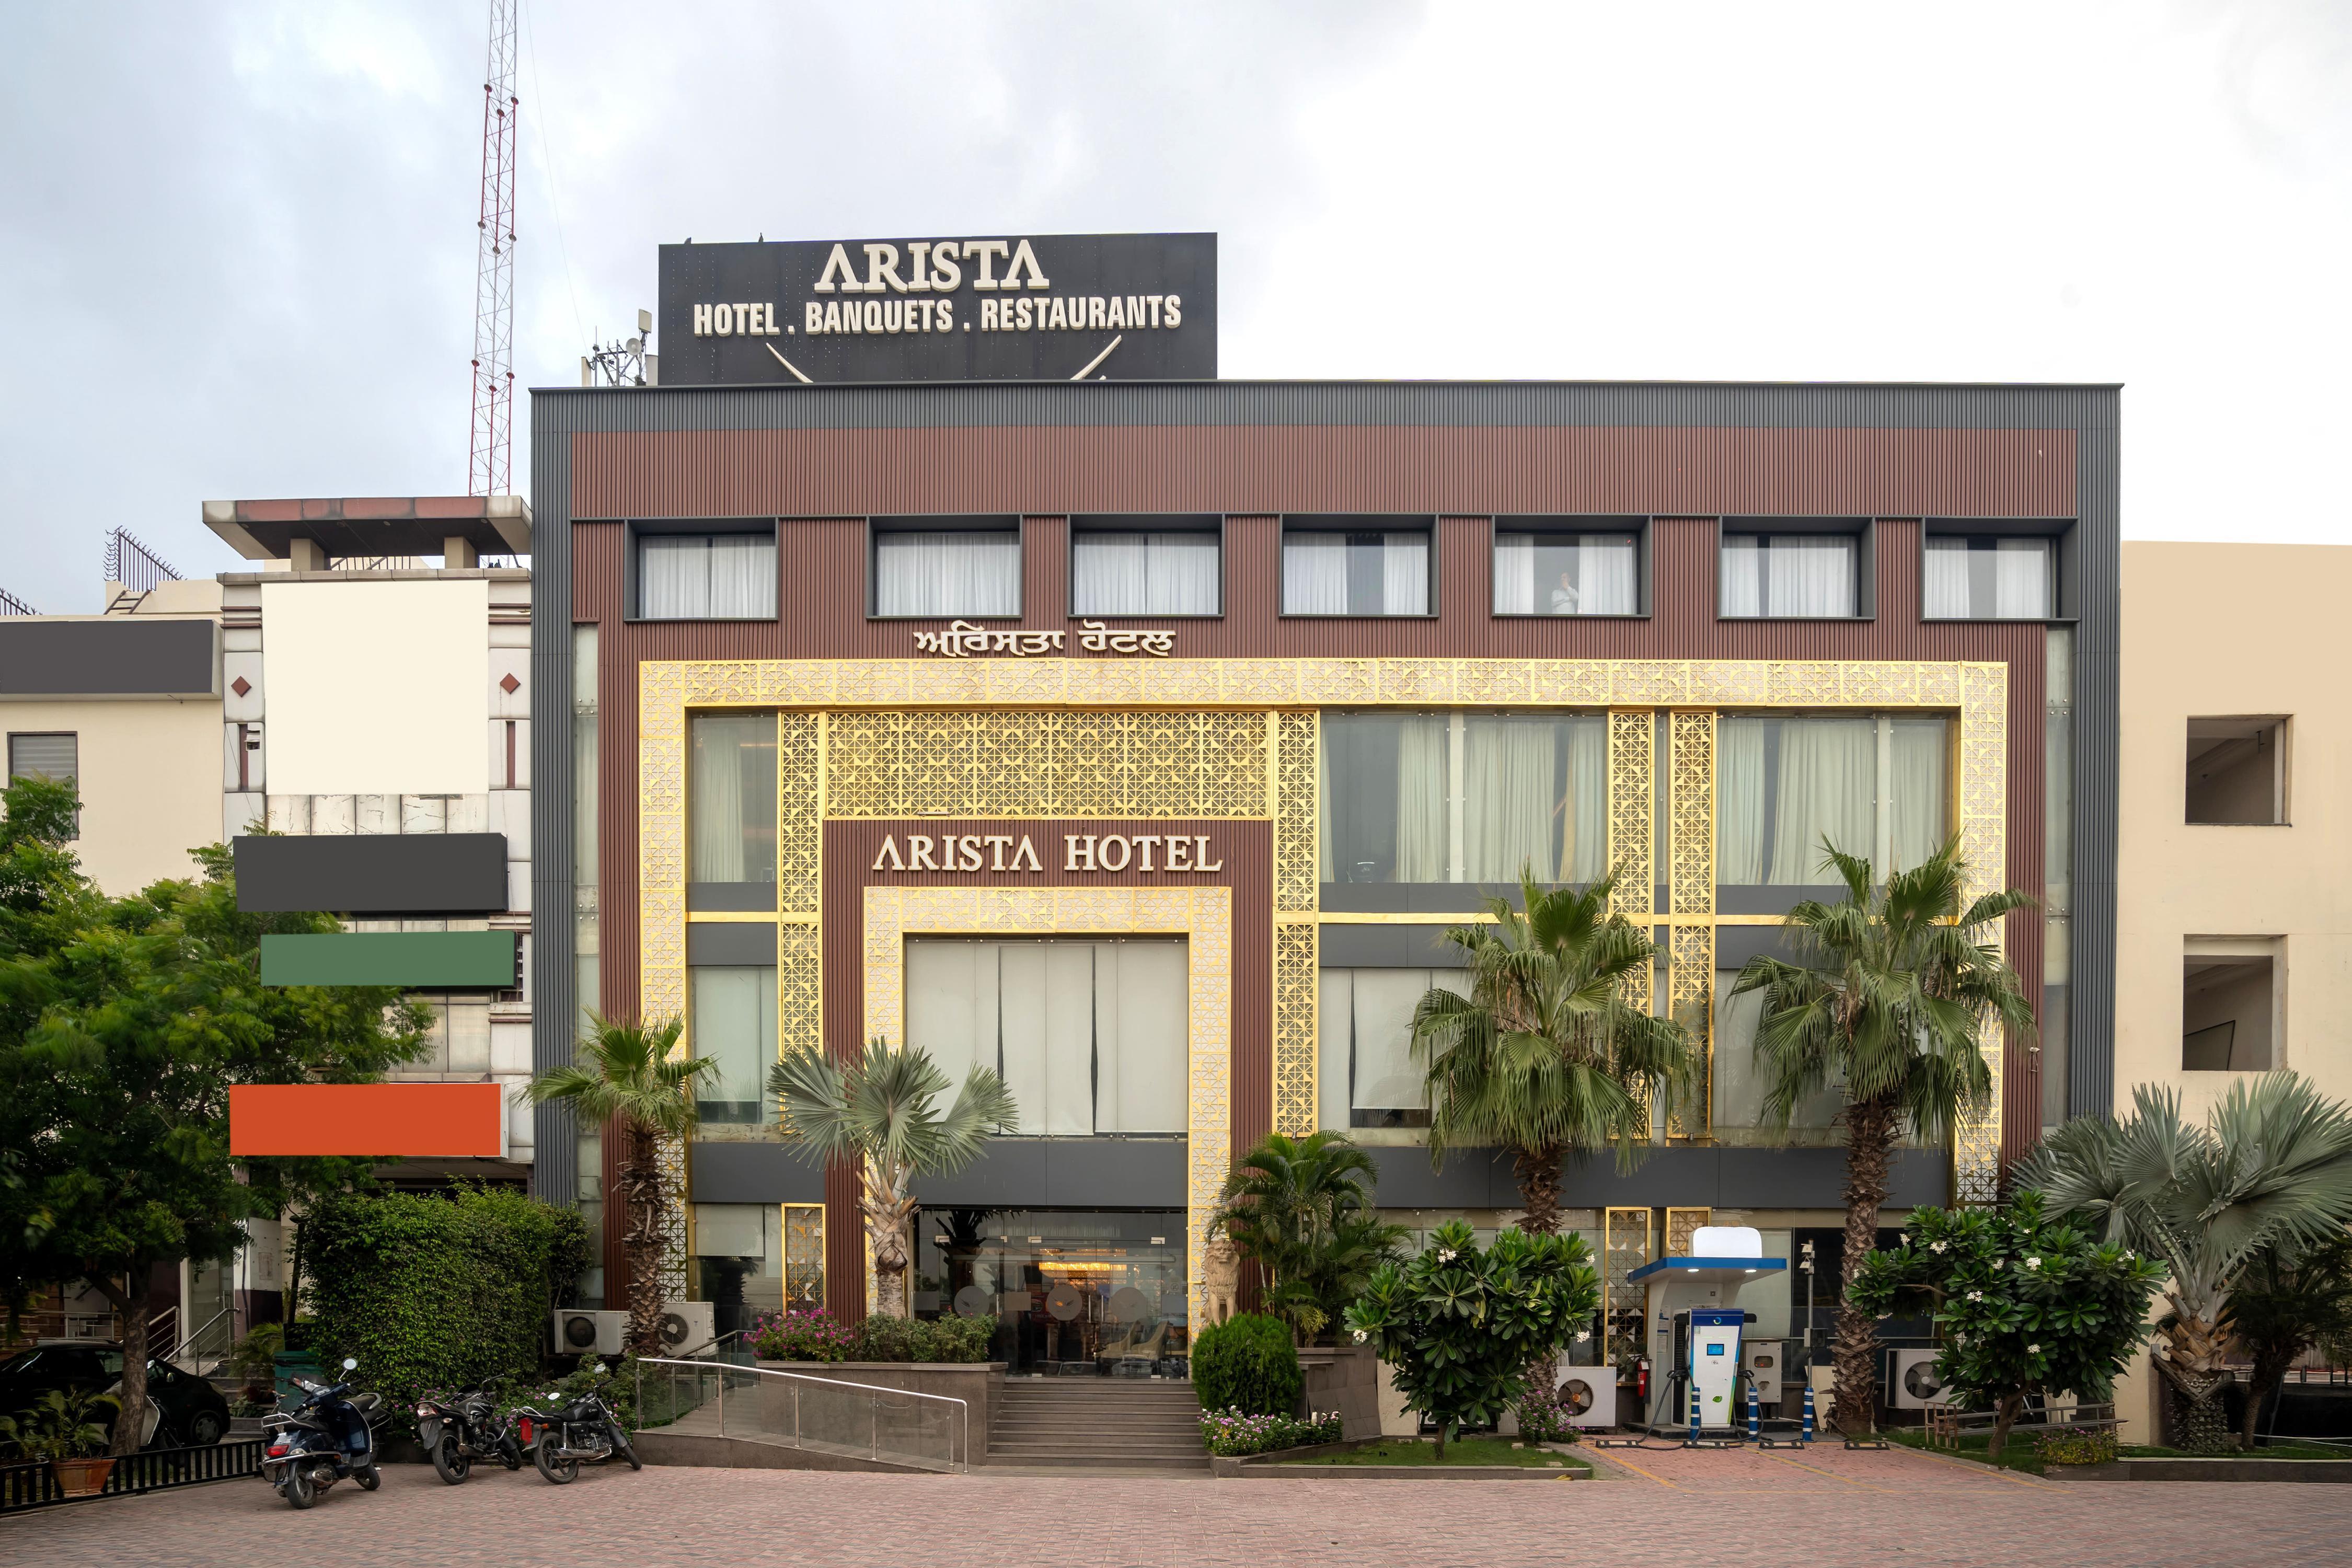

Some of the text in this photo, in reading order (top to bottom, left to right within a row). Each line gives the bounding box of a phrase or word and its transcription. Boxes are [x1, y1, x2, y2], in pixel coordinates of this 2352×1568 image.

[814, 239, 1050, 294] ARISTA
[805, 299, 954, 335] BANQUETS
[981, 294, 1182, 332] RESTAURANTS
[1077, 618, 1177, 657] ਹੋਟਲ
[871, 834, 1224, 871] ARISTA HOTEL
